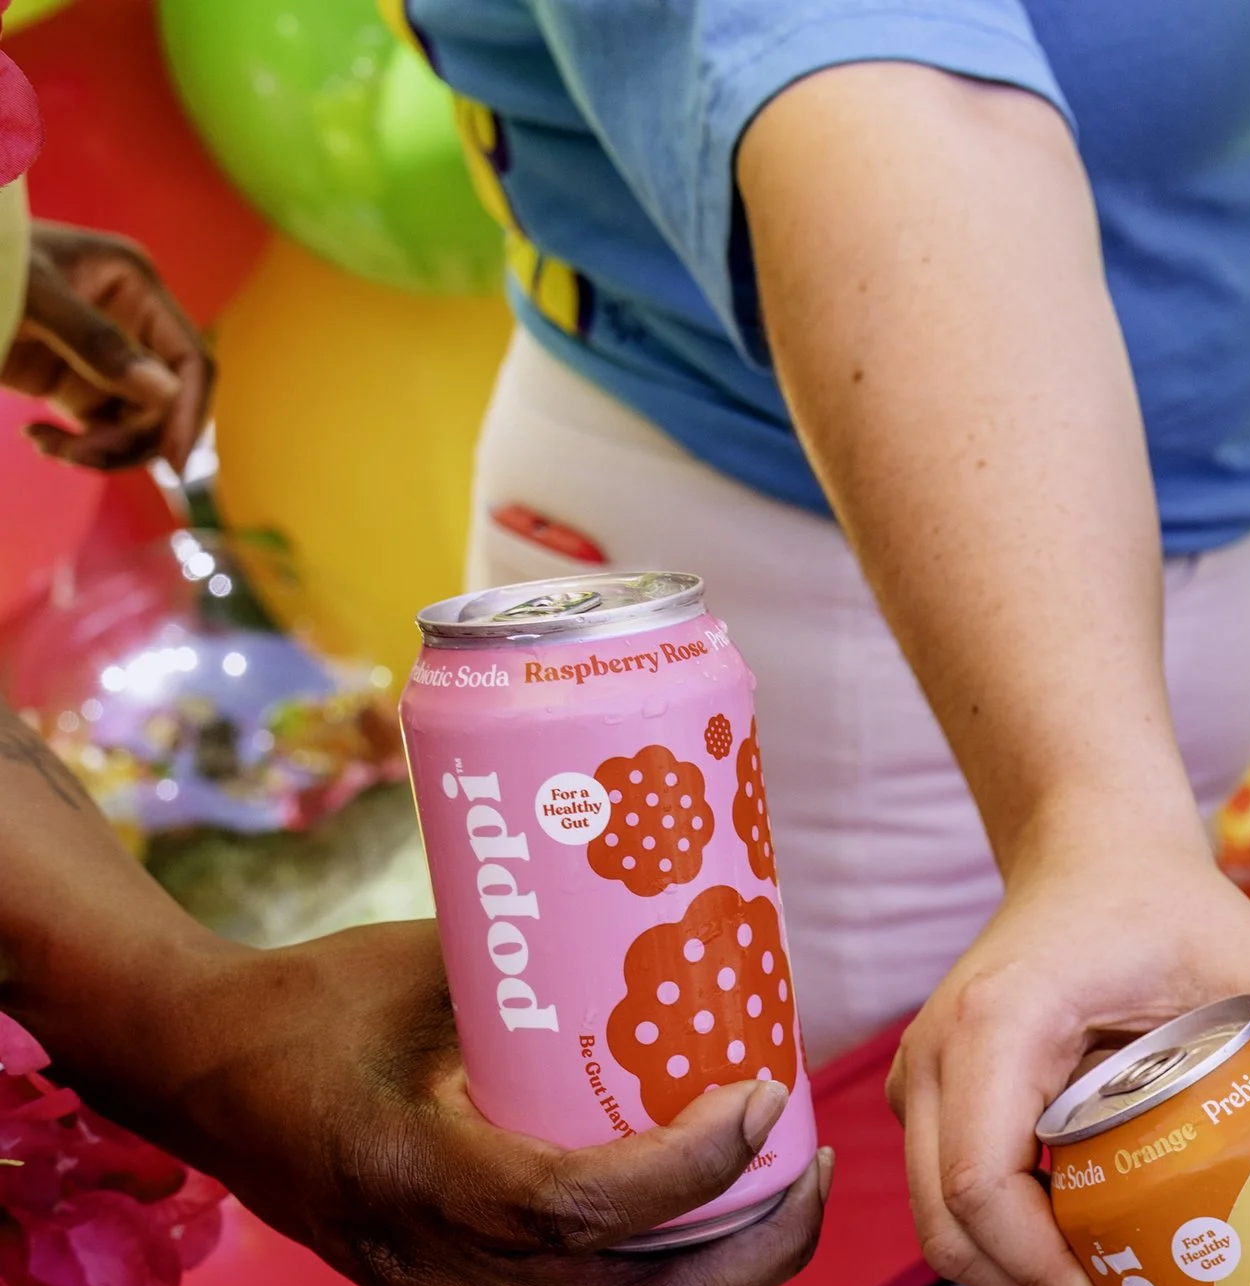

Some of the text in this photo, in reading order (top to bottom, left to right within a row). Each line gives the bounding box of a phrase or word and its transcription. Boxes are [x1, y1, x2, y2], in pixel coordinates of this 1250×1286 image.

[455, 664, 510, 688] Soda
[524, 651, 660, 685] Raspberry
[659, 639, 709, 665] Rose
[551, 787, 579, 802] For
[543, 801, 603, 816] Healthy
[560, 817, 590, 830] Gut
[441, 771, 560, 1033] poppi
[578, 1035, 596, 1058] Be
[585, 1061, 607, 1096] Gut
[1066, 1159, 1106, 1190] Soda
[1114, 1122, 1198, 1175] Orange
[1180, 1235, 1230, 1266] Healthy
[1182, 1233, 1205, 1250] For
[1200, 1253, 1227, 1270] Gut
